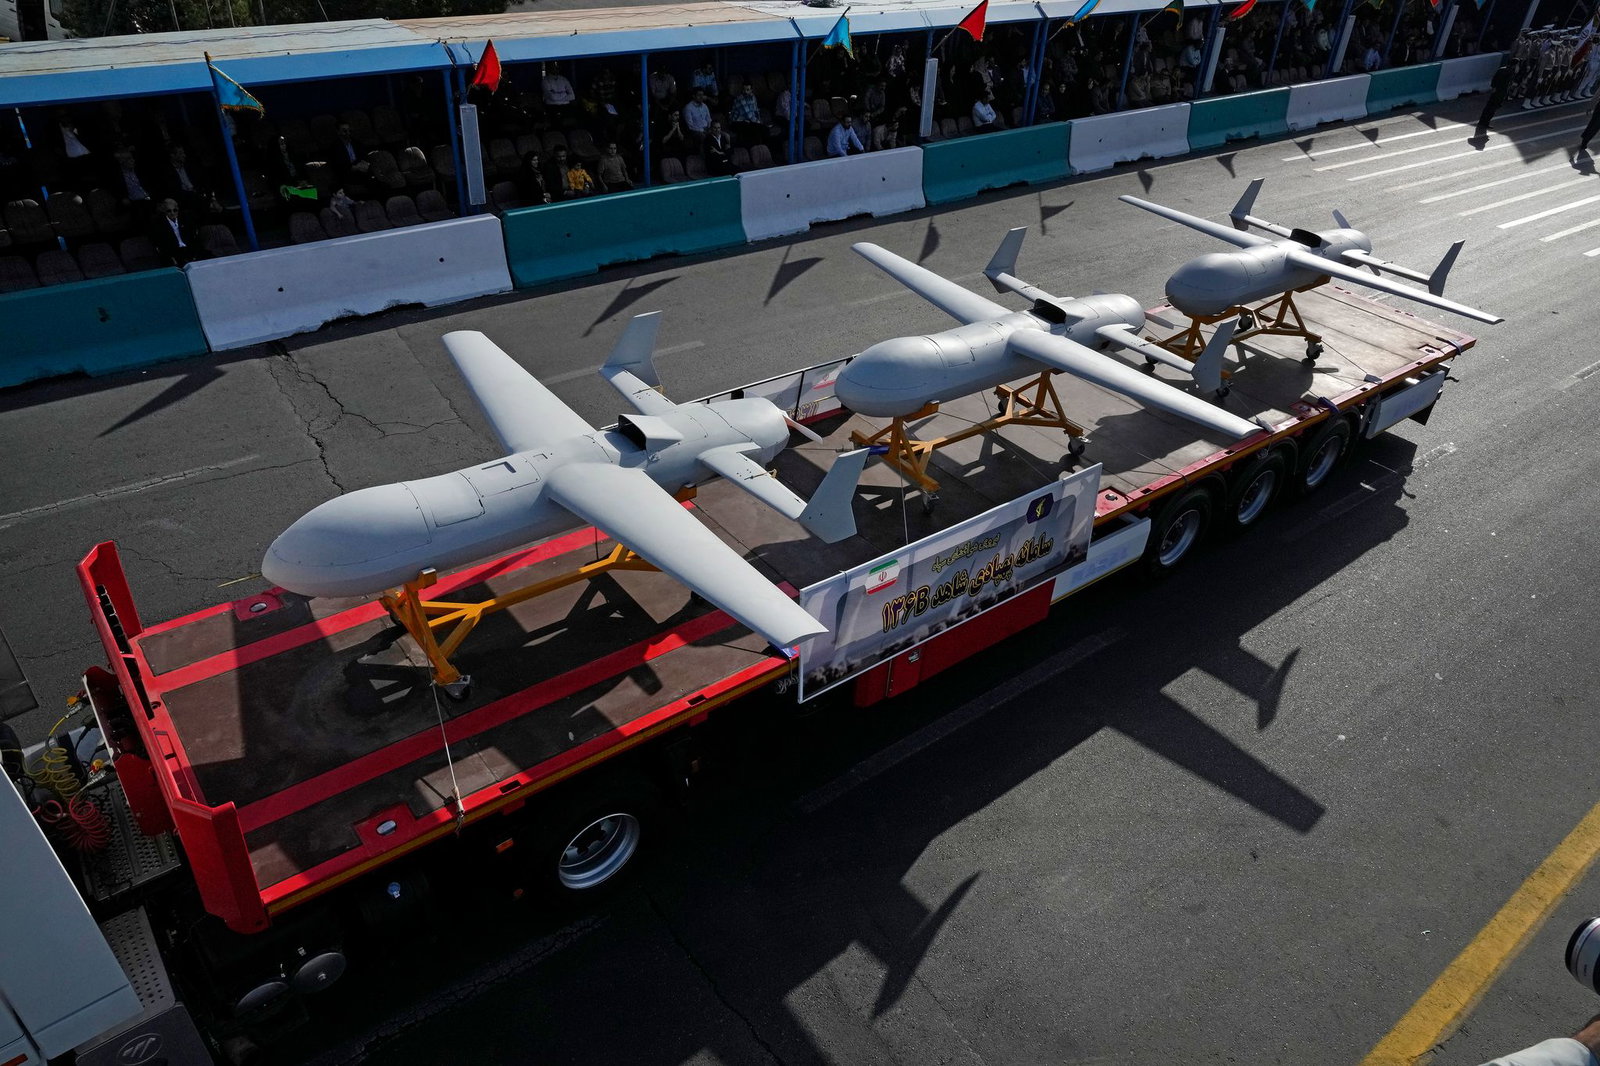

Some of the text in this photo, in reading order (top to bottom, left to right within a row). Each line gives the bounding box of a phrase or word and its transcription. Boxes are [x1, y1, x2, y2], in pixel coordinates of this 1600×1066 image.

[1014, 532, 1054, 567] سامانه
[931, 569, 969, 608] شاهد
[968, 553, 1014, 597] پهپادی
